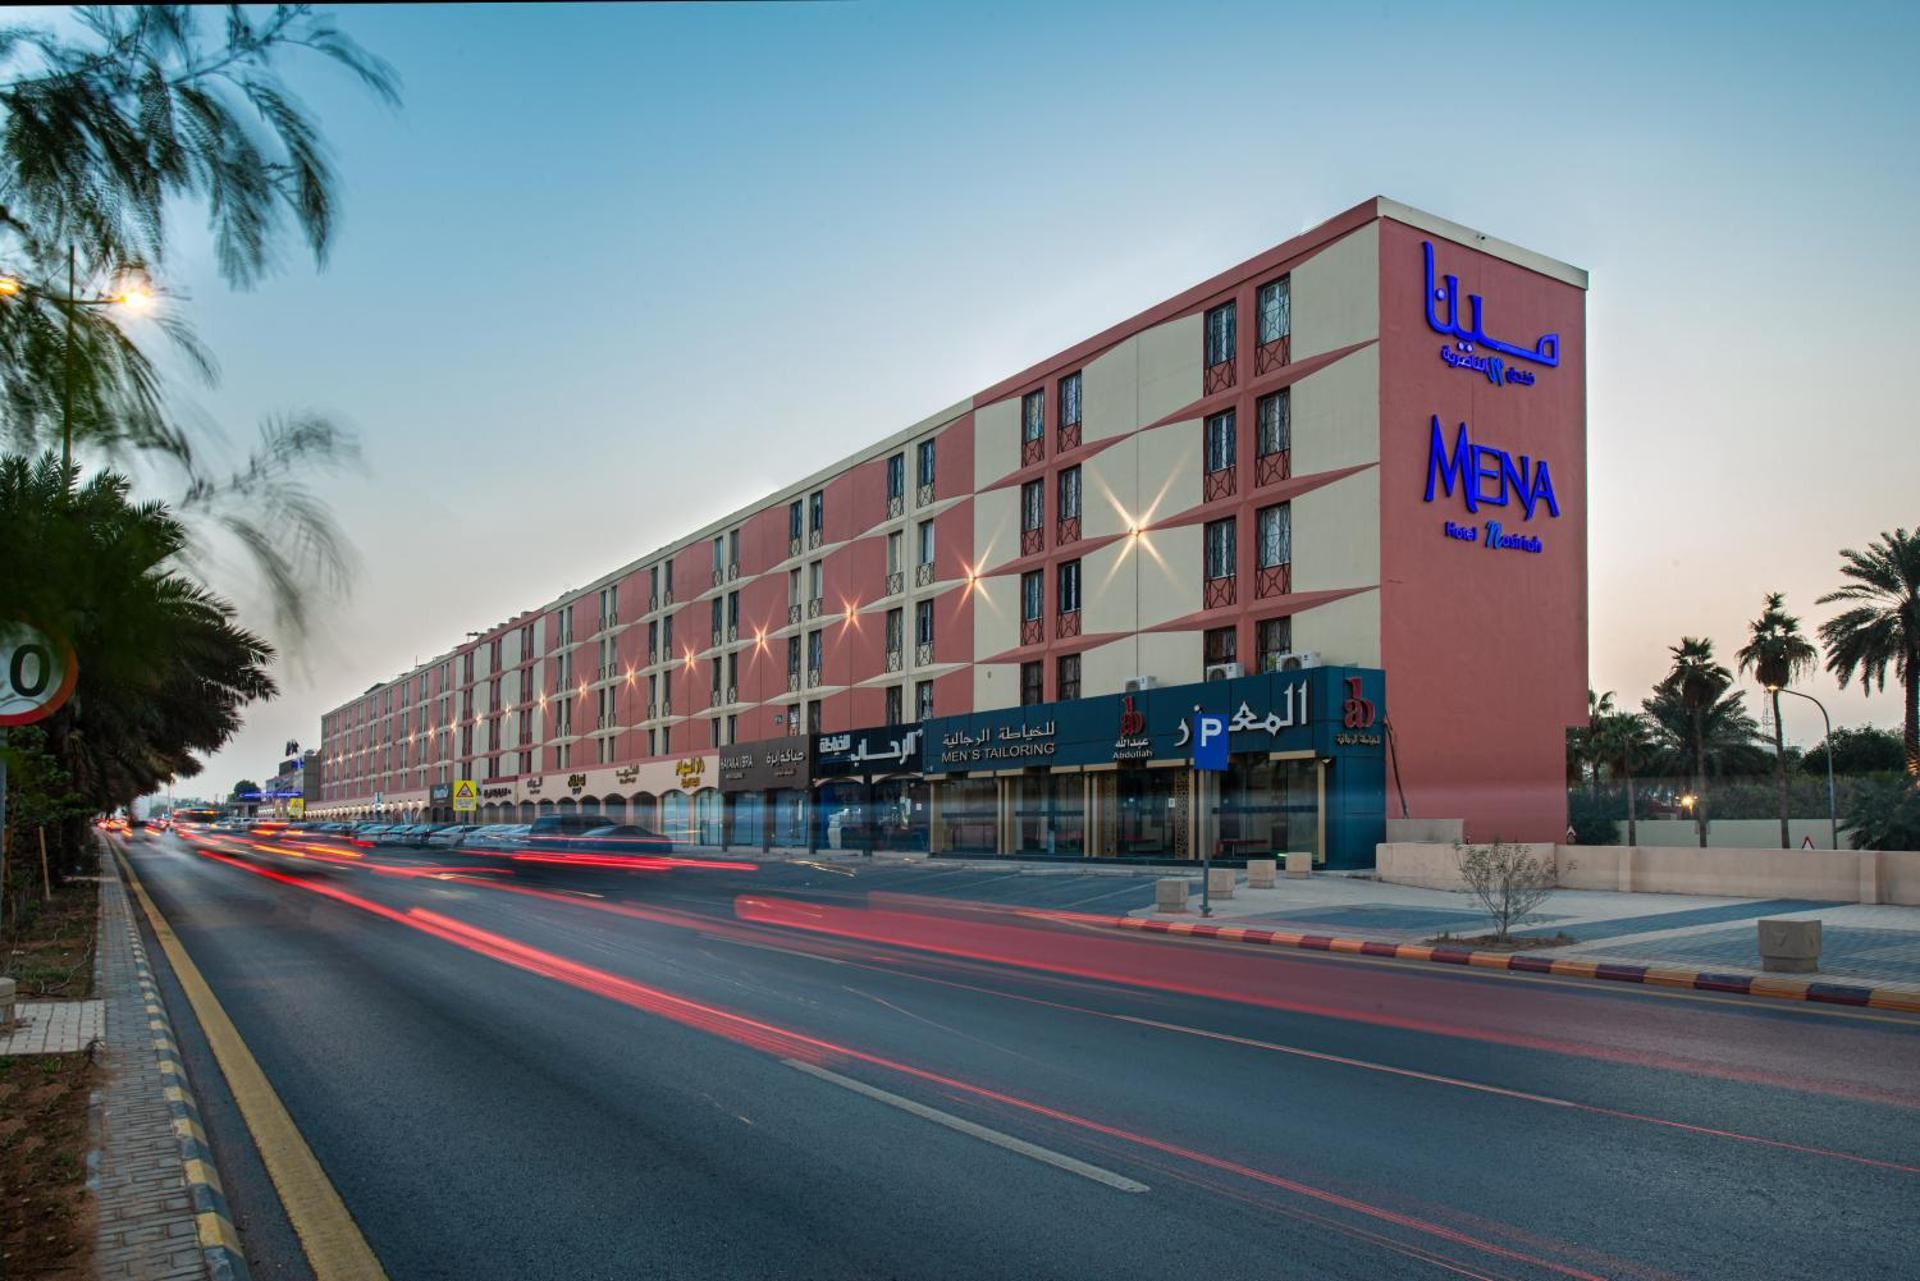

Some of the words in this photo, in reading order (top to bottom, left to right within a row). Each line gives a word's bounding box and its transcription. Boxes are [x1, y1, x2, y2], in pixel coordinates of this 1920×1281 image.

[1422, 240, 1560, 368] مينا
[1423, 414, 1560, 520] MENA
[1444, 521, 1478, 541] Hotel
[943, 728, 990, 748] الرجالية
[999, 720, 1055, 741] للخياطة
[1201, 718, 1222, 747] P
[985, 743, 1055, 759] TAILORING
[1115, 737, 1149, 749] عبدالله
